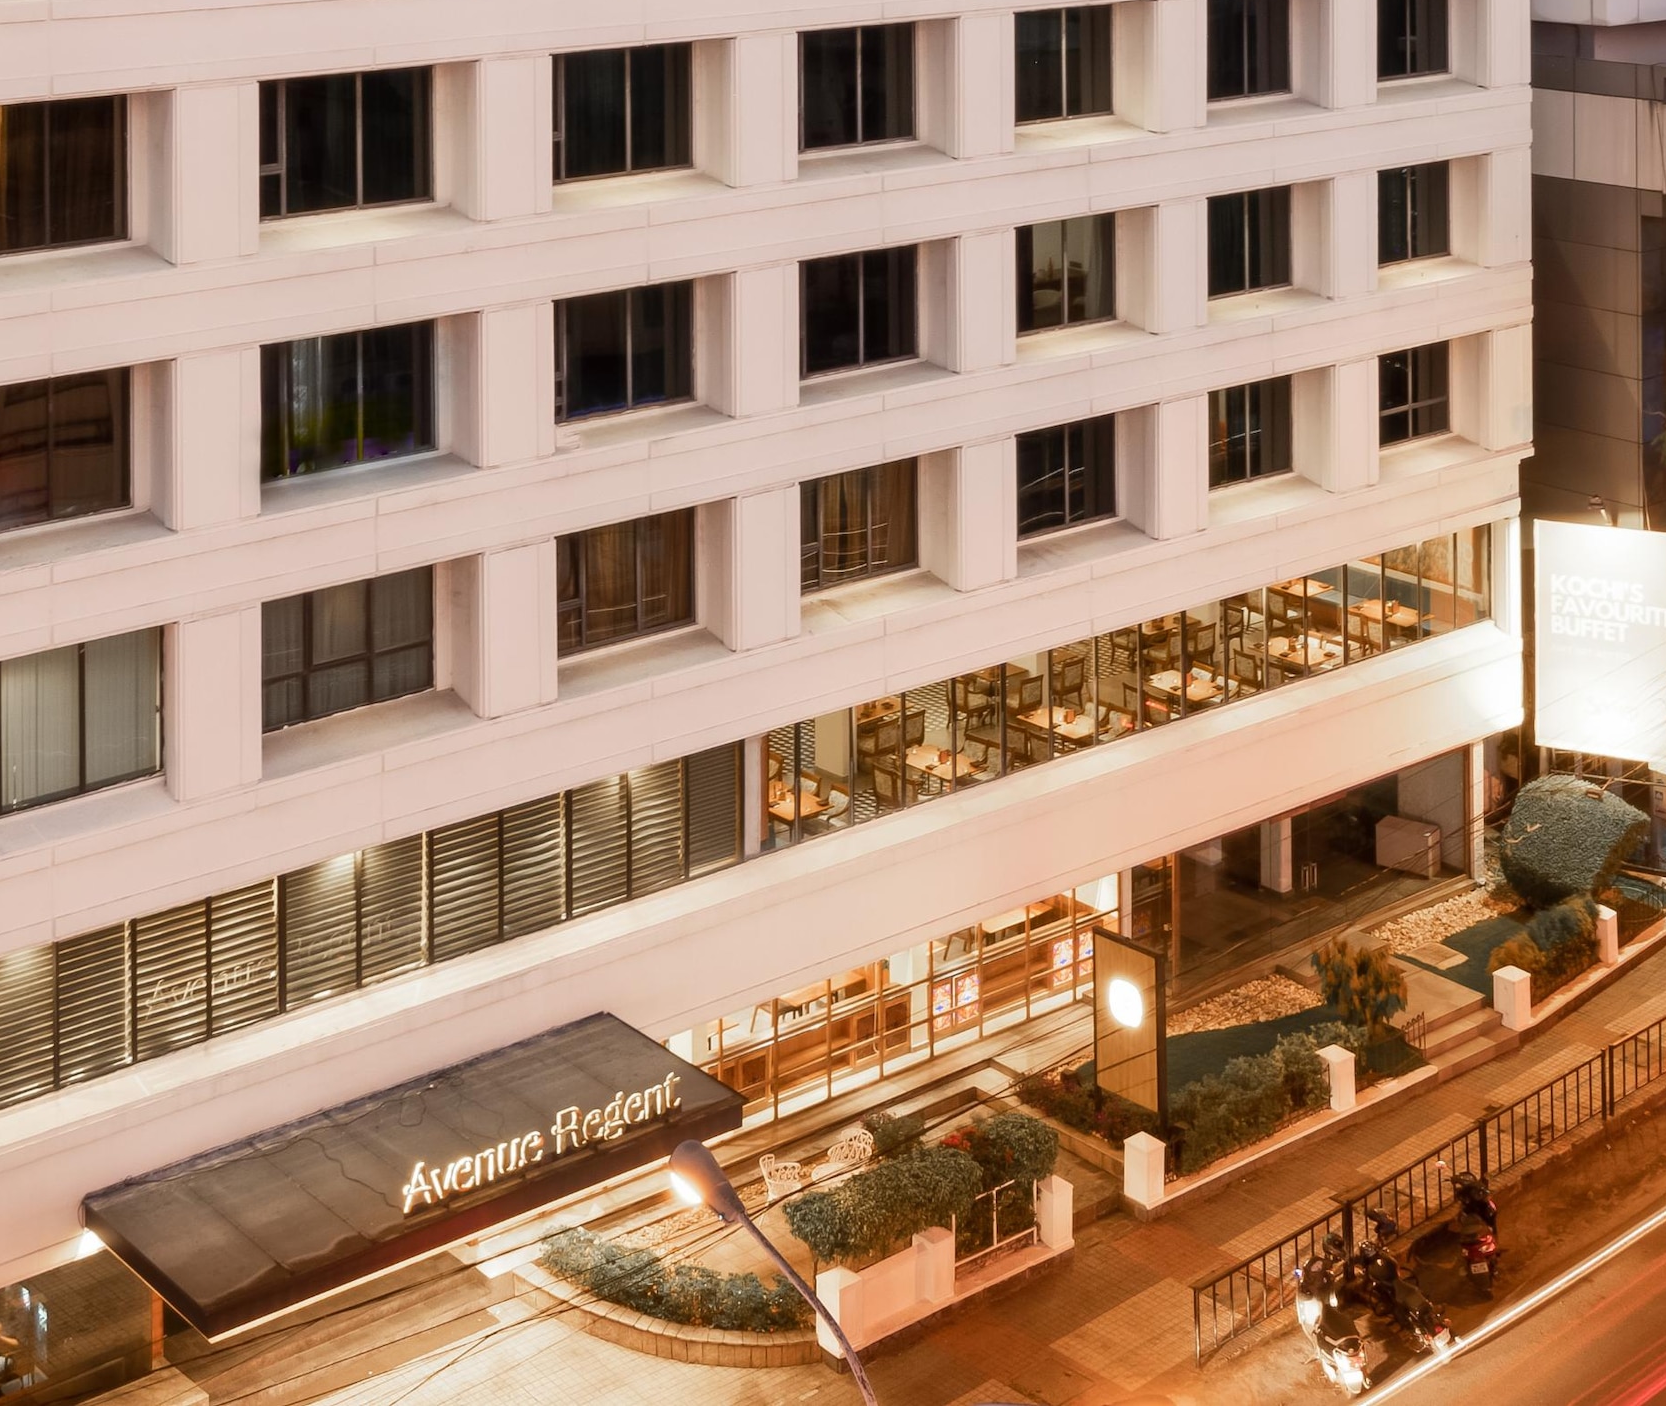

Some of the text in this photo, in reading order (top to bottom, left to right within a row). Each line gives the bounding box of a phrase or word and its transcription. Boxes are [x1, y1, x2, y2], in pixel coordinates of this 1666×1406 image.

[1550, 573, 1644, 603] KOCHI'S
[1551, 615, 1630, 643] BUFFET
[402, 1071, 681, 1214] Avenue Regent
